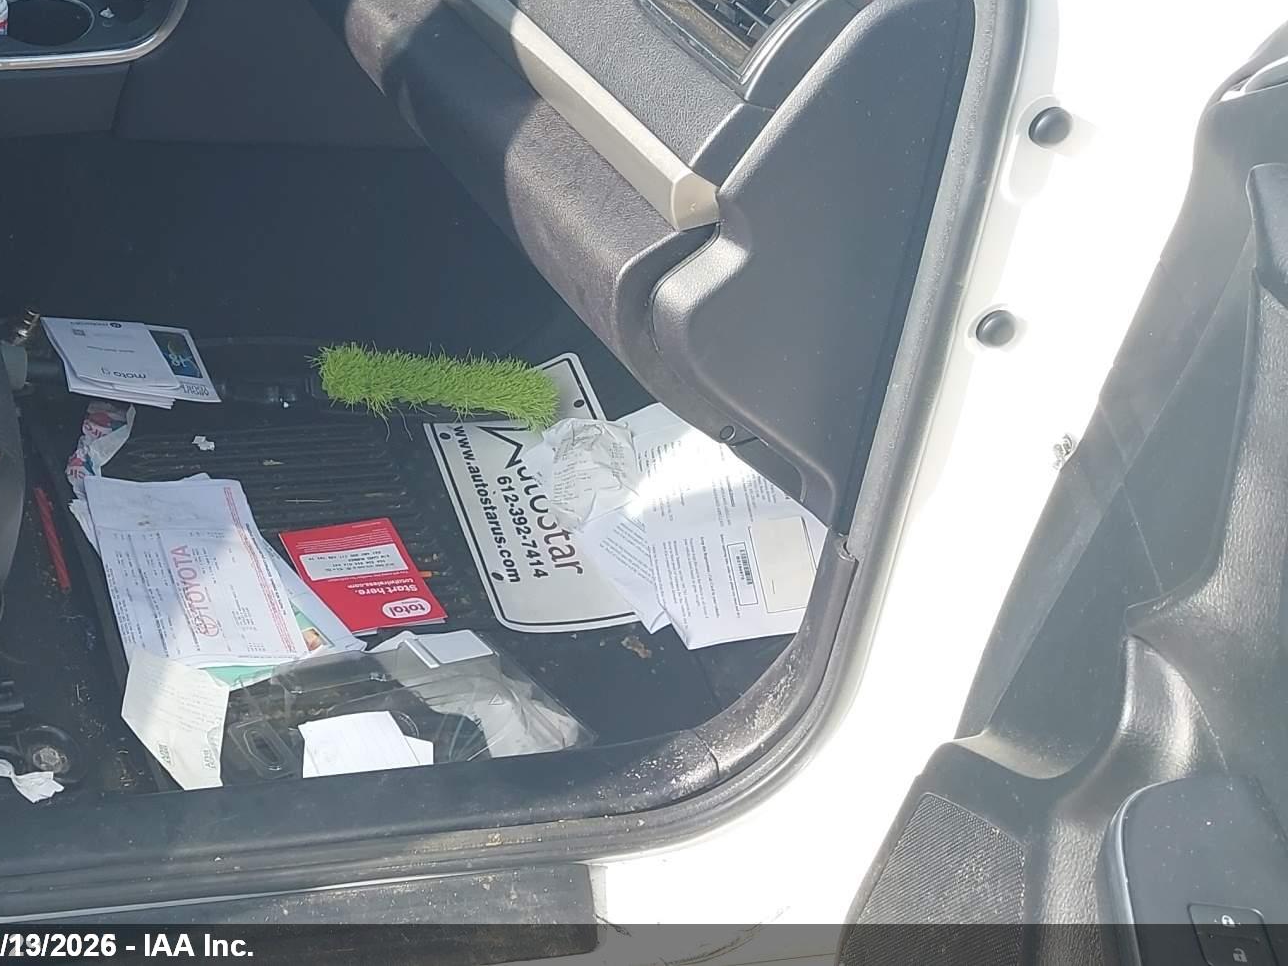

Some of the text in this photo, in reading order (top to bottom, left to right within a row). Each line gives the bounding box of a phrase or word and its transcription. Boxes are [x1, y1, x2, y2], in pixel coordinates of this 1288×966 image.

[453, 425, 521, 583] www.autostarus.com
[496, 475, 549, 579] 612-392-7414
[170, 544, 209, 613] TOYOTA
[354, 583, 418, 596] Start here.
[388, 602, 426, 617] total
